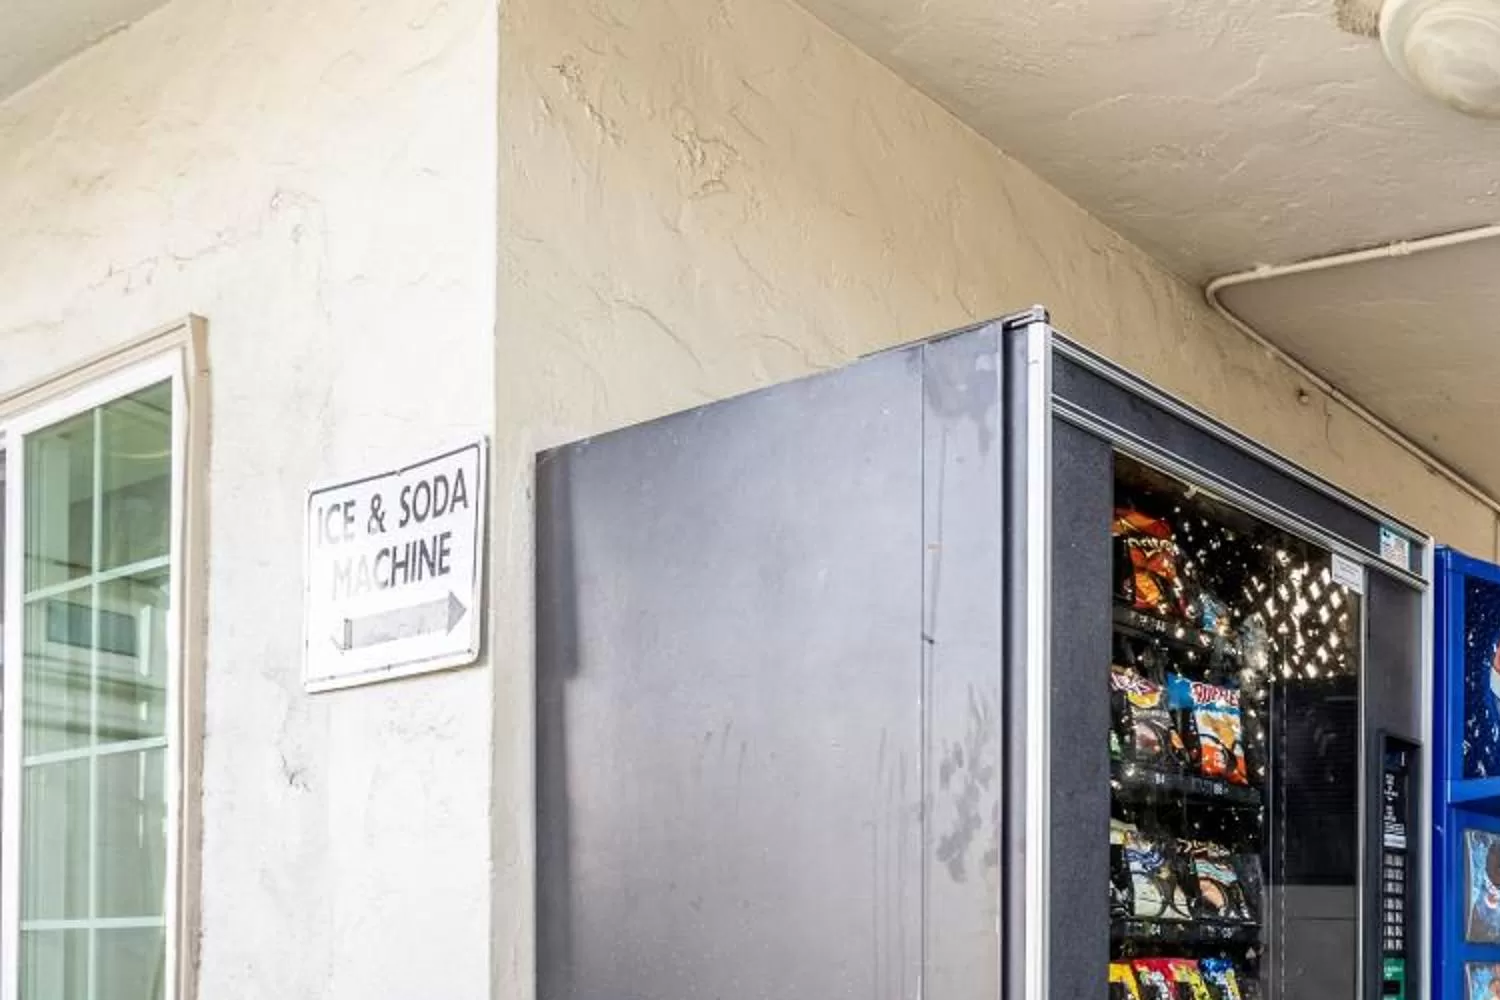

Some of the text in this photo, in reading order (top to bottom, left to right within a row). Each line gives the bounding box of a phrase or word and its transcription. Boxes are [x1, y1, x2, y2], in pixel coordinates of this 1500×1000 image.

[317, 467, 469, 548] ICE & SODA
[333, 531, 452, 600] MACHINE
